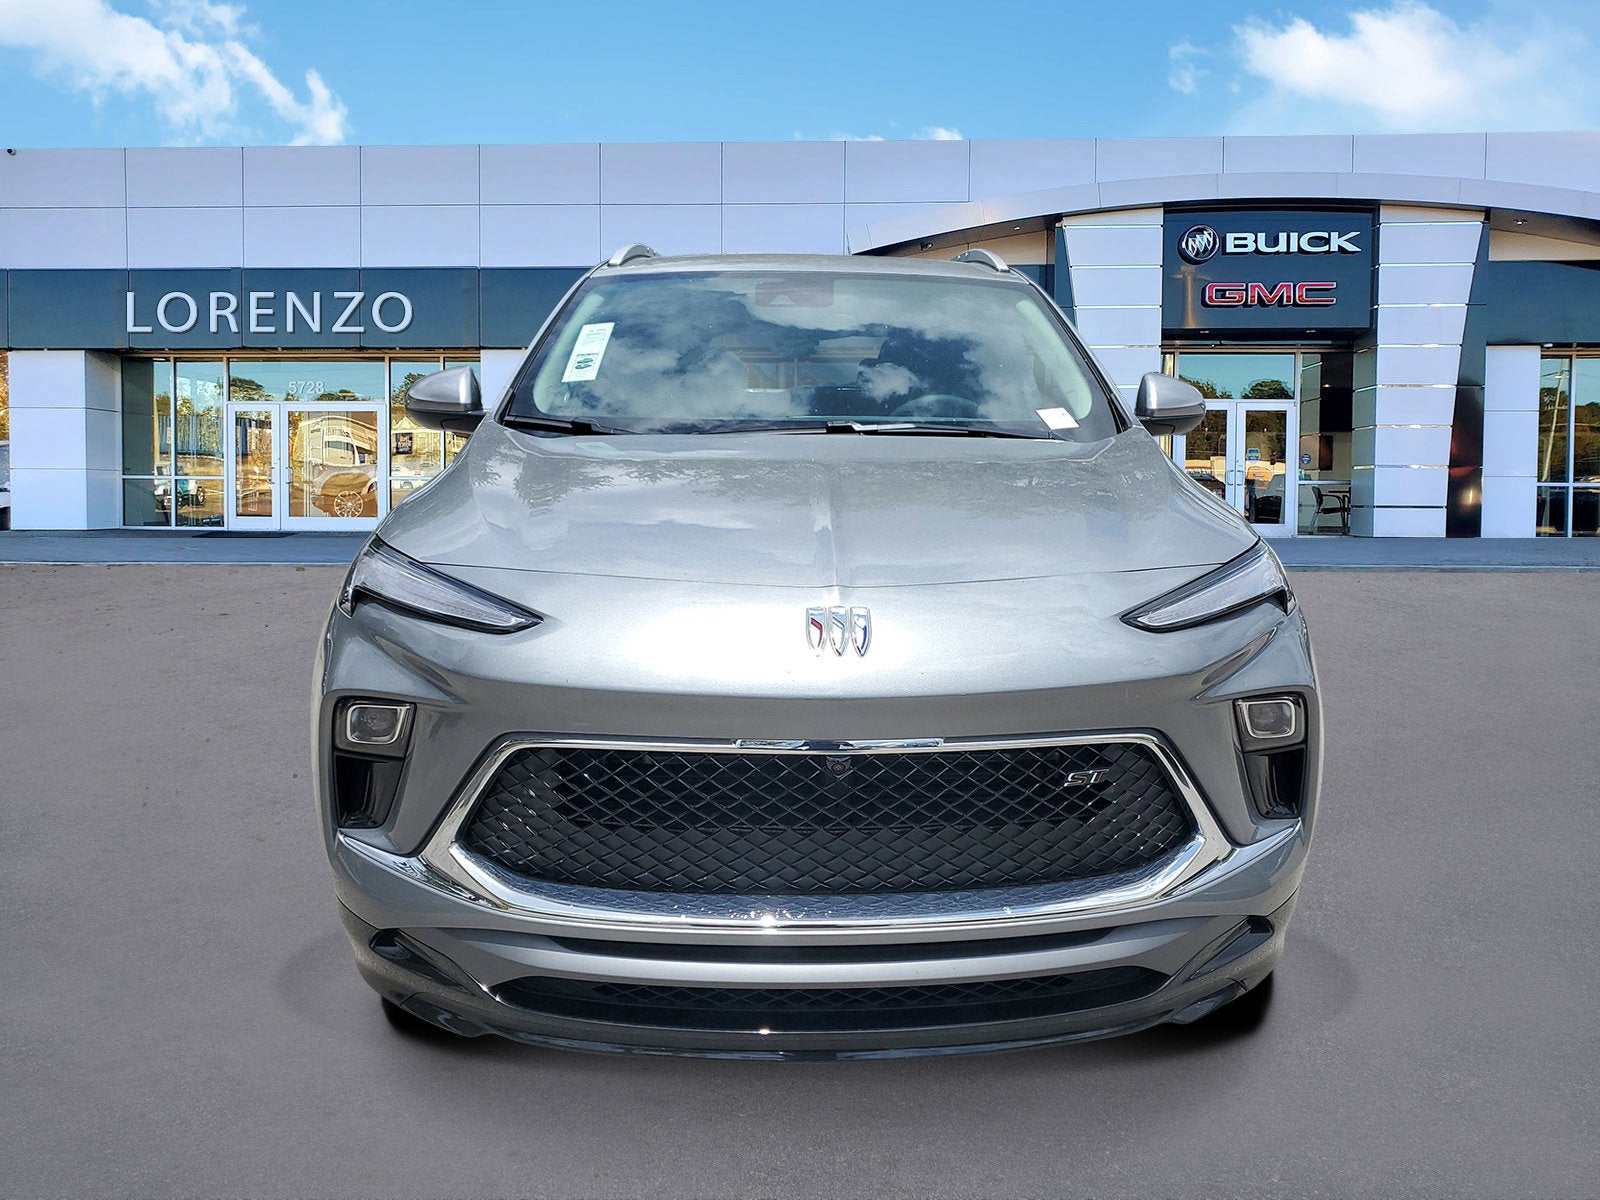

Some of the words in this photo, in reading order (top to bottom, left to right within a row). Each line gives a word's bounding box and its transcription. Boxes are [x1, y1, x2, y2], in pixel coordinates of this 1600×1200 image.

[1225, 231, 1362, 253] BUICK
[1206, 282, 1336, 305] GMC
[126, 291, 413, 333] LORENZO
[288, 380, 325, 394] 5728
[1064, 768, 1110, 786] ST
